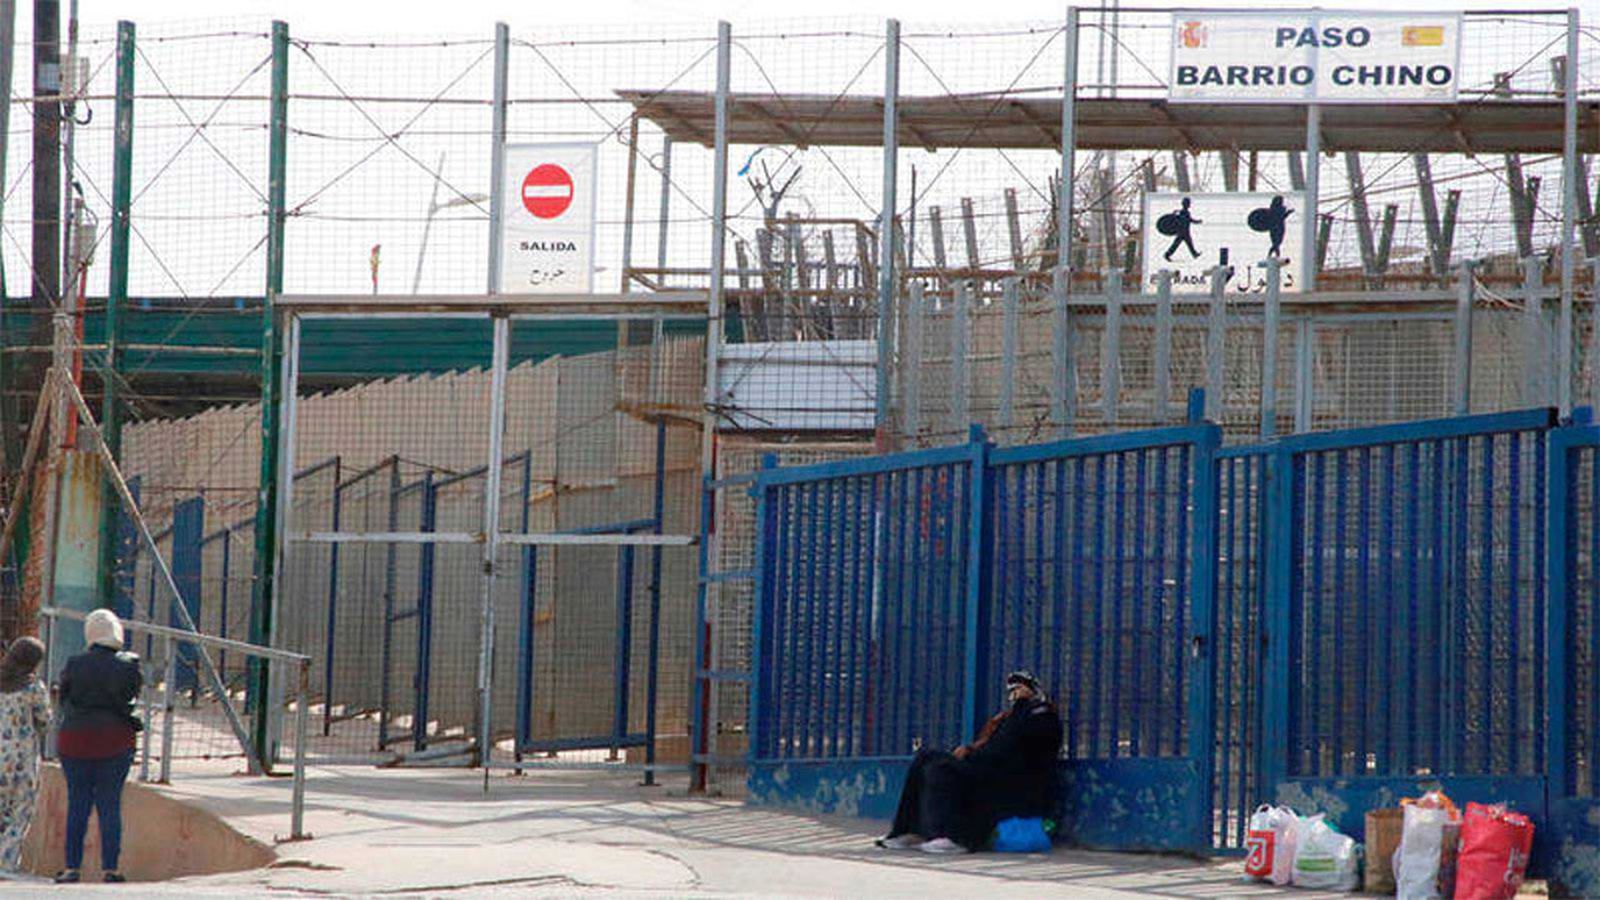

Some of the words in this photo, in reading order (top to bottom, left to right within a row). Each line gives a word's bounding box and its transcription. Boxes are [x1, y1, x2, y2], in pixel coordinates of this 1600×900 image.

[1275, 26, 1371, 48] PASO
[1176, 65, 1315, 86] BARRIO
[1331, 65, 1452, 86] CHINO
[520, 241, 577, 252] SALIDA
[1150, 273, 1207, 285] ERADA
[1237, 265, 1295, 293] دول
